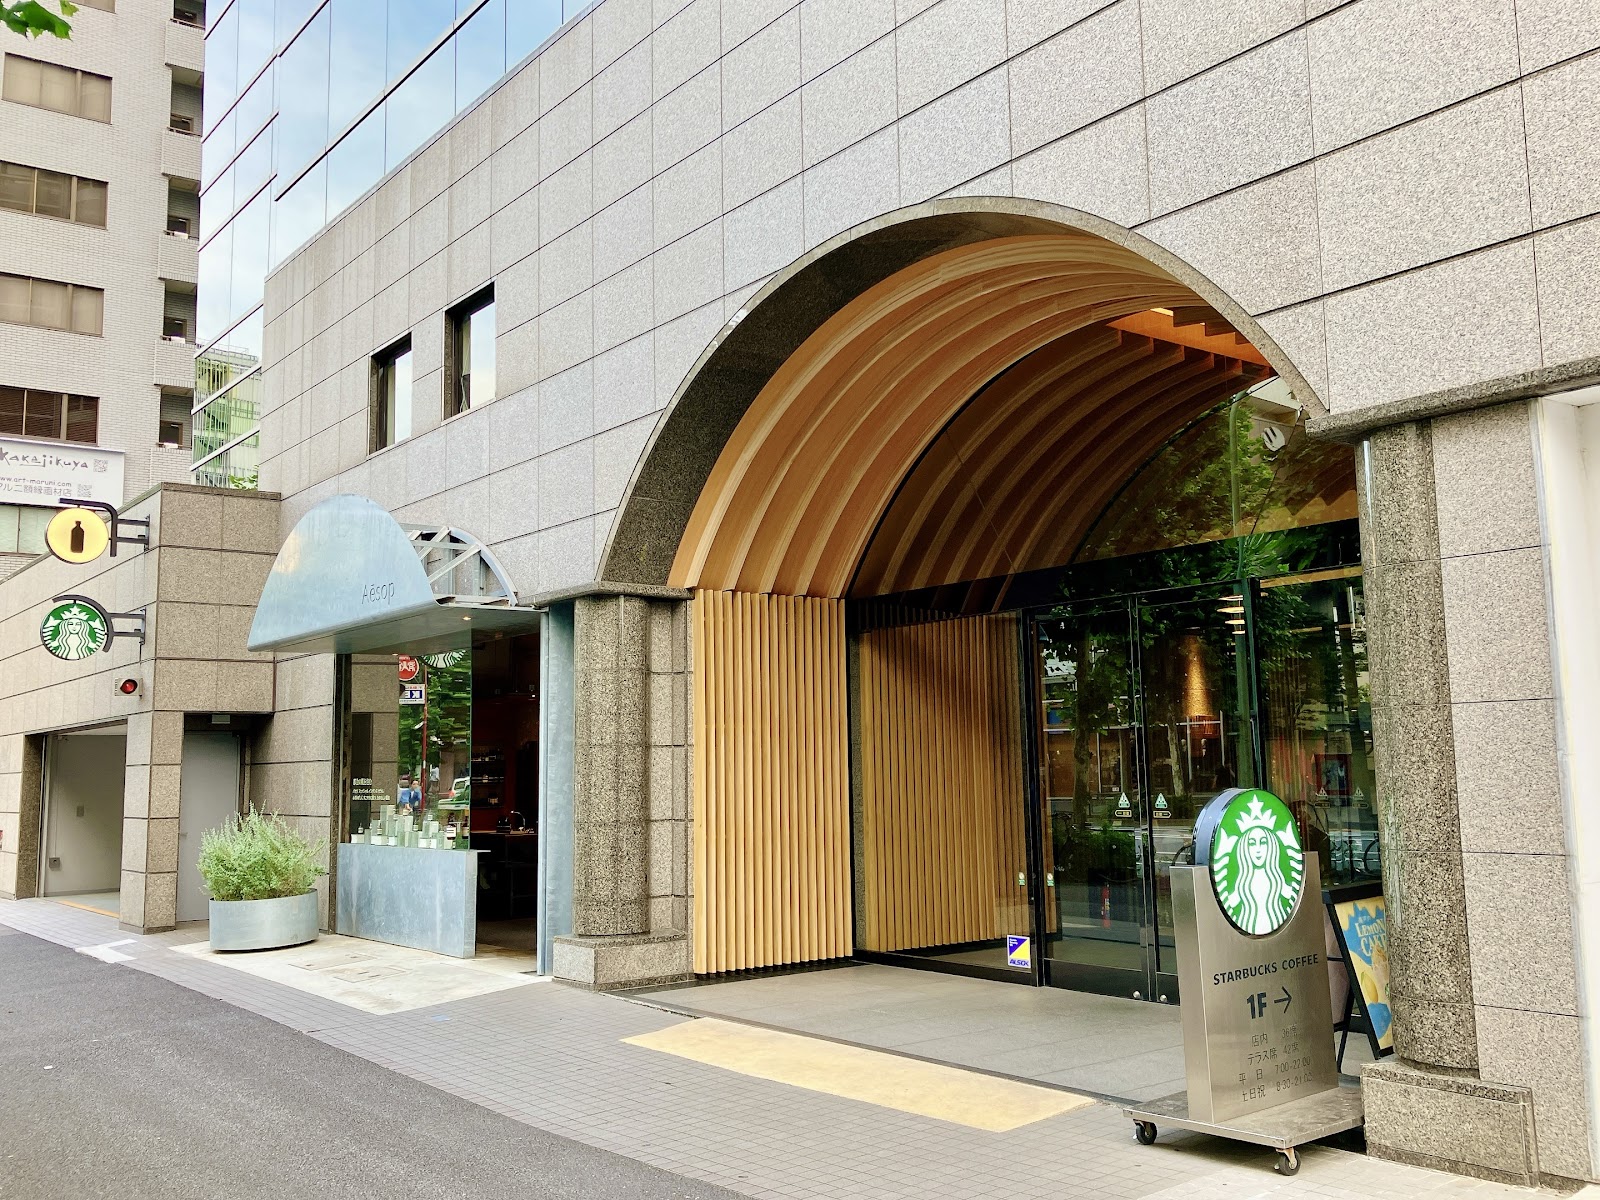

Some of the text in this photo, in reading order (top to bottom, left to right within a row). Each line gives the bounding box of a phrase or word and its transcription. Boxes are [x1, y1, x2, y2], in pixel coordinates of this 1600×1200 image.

[1213, 953, 1319, 986] STARBUCKS COFFEE
[1247, 992, 1267, 1019] 1F
[1251, 1032, 1268, 1047] 店内
[1248, 1047, 1277, 1066] テラス席
